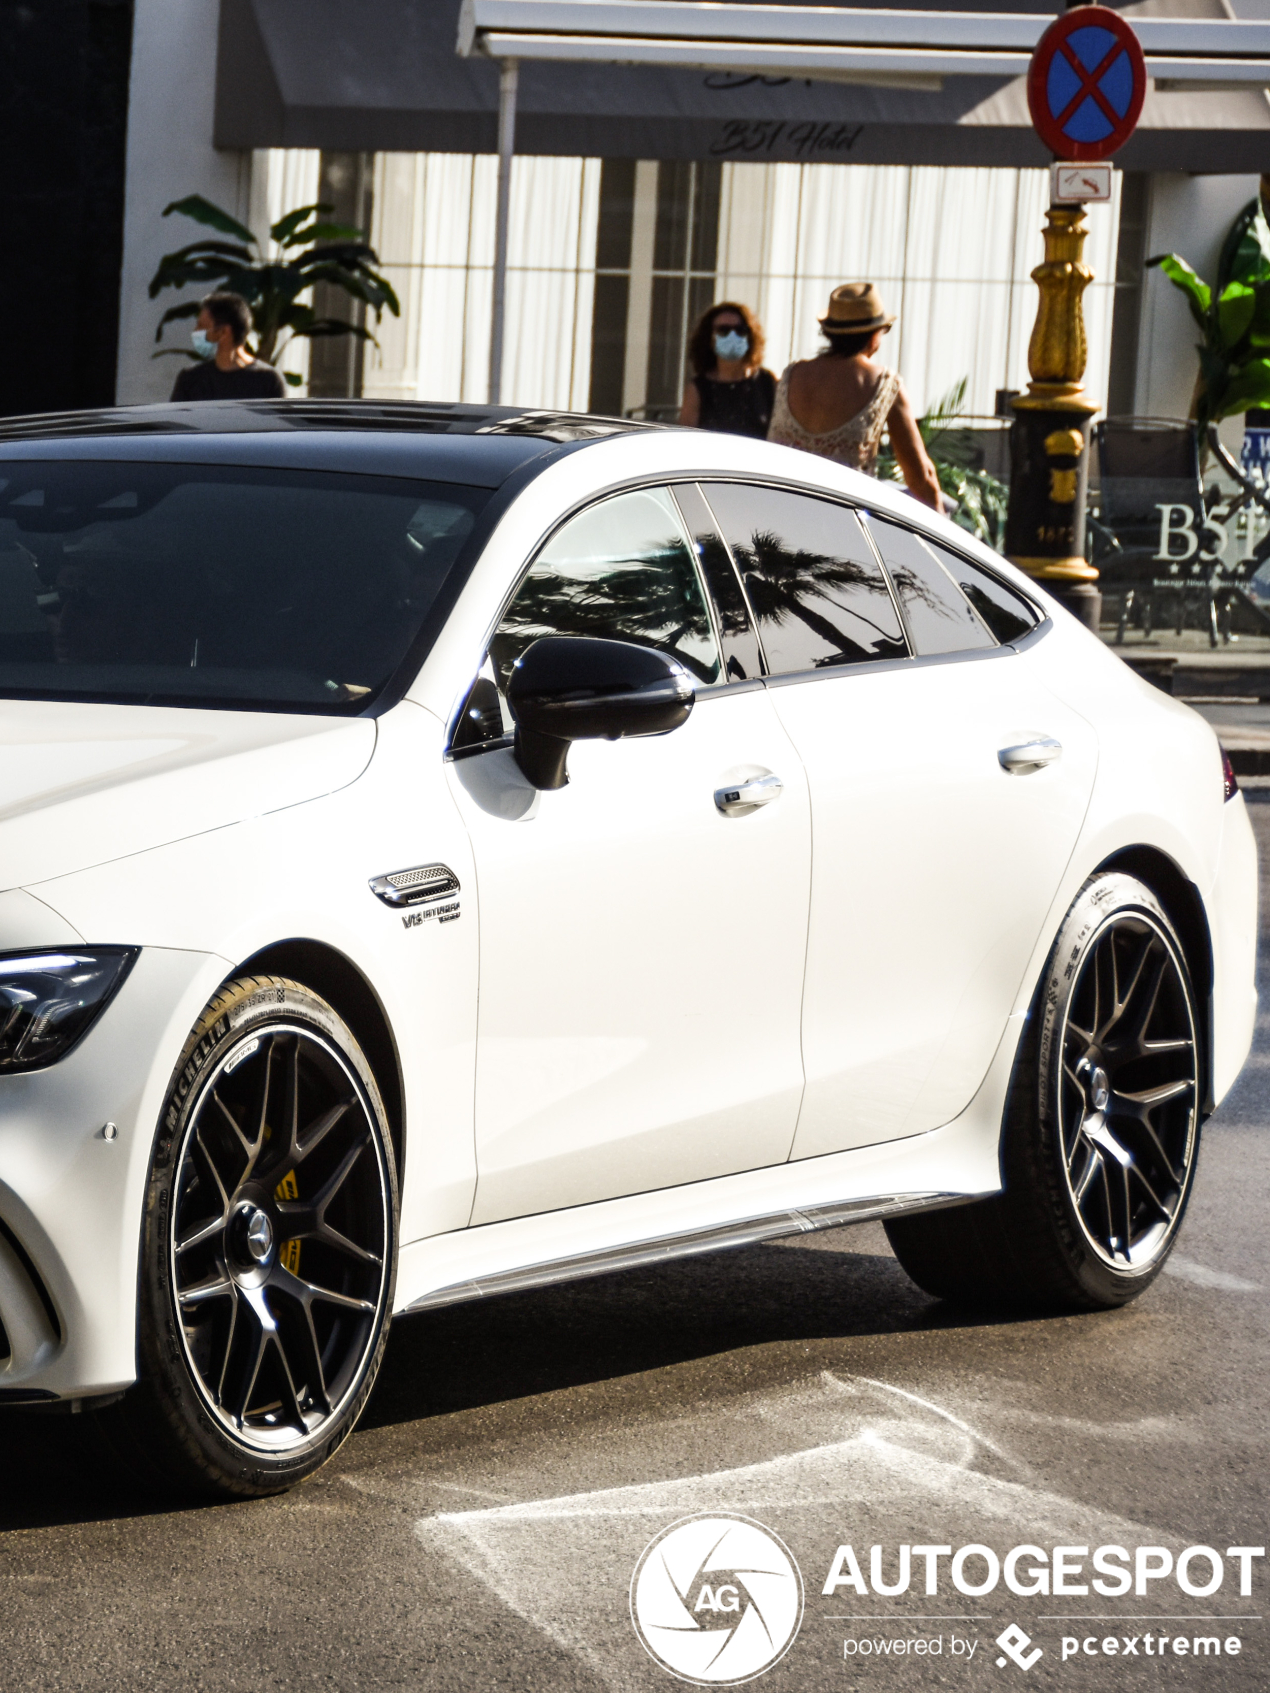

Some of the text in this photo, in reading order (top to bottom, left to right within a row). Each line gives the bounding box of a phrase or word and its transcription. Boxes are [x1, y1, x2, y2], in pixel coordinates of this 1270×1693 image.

[709, 119, 865, 155] B51 Hotel
[1152, 503, 1259, 562] B51
[165, 1018, 226, 1131] MICHELIN
